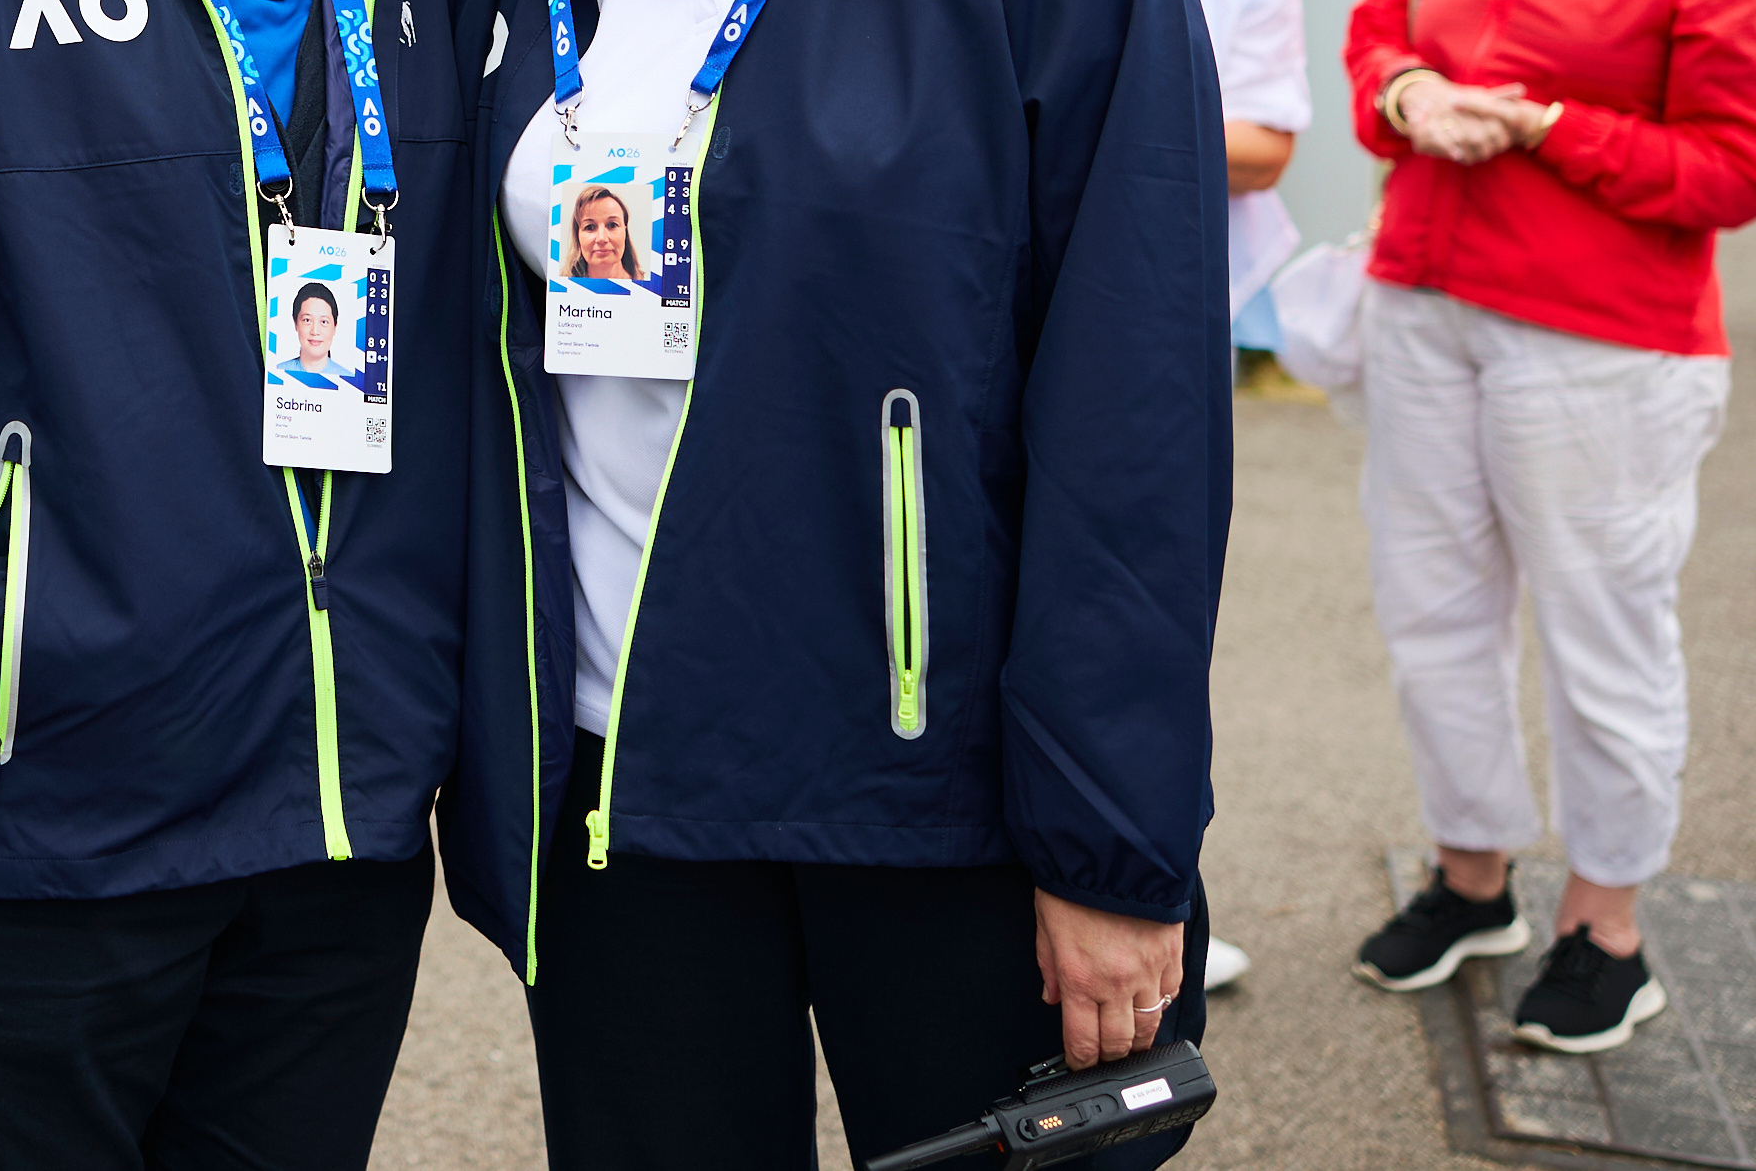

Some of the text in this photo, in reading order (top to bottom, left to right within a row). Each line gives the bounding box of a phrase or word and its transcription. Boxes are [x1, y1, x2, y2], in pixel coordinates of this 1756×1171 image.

[723, 3, 748, 42] AO
[555, 20, 571, 56] AO
[248, 97, 268, 137] AO
[362, 97, 381, 137] AO
[607, 147, 641, 159] AO26
[668, 171, 691, 182] 0 1
[667, 186, 690, 198] 2 3
[667, 203, 690, 215] 4 5
[666, 238, 689, 250] 8 9
[318, 245, 347, 258] AO26
[369, 272, 389, 285] 0 1
[369, 286, 388, 299] 2 3
[677, 285, 690, 295] T1
[665, 299, 689, 307] MATCH
[368, 303, 387, 316] 4 5
[559, 304, 613, 319] Martina
[367, 337, 387, 349] 8 9
[376, 382, 387, 392] T1
[276, 396, 323, 413] Sabrina
[367, 395, 387, 404] MATCH
[275, 413, 293, 422] Wang
